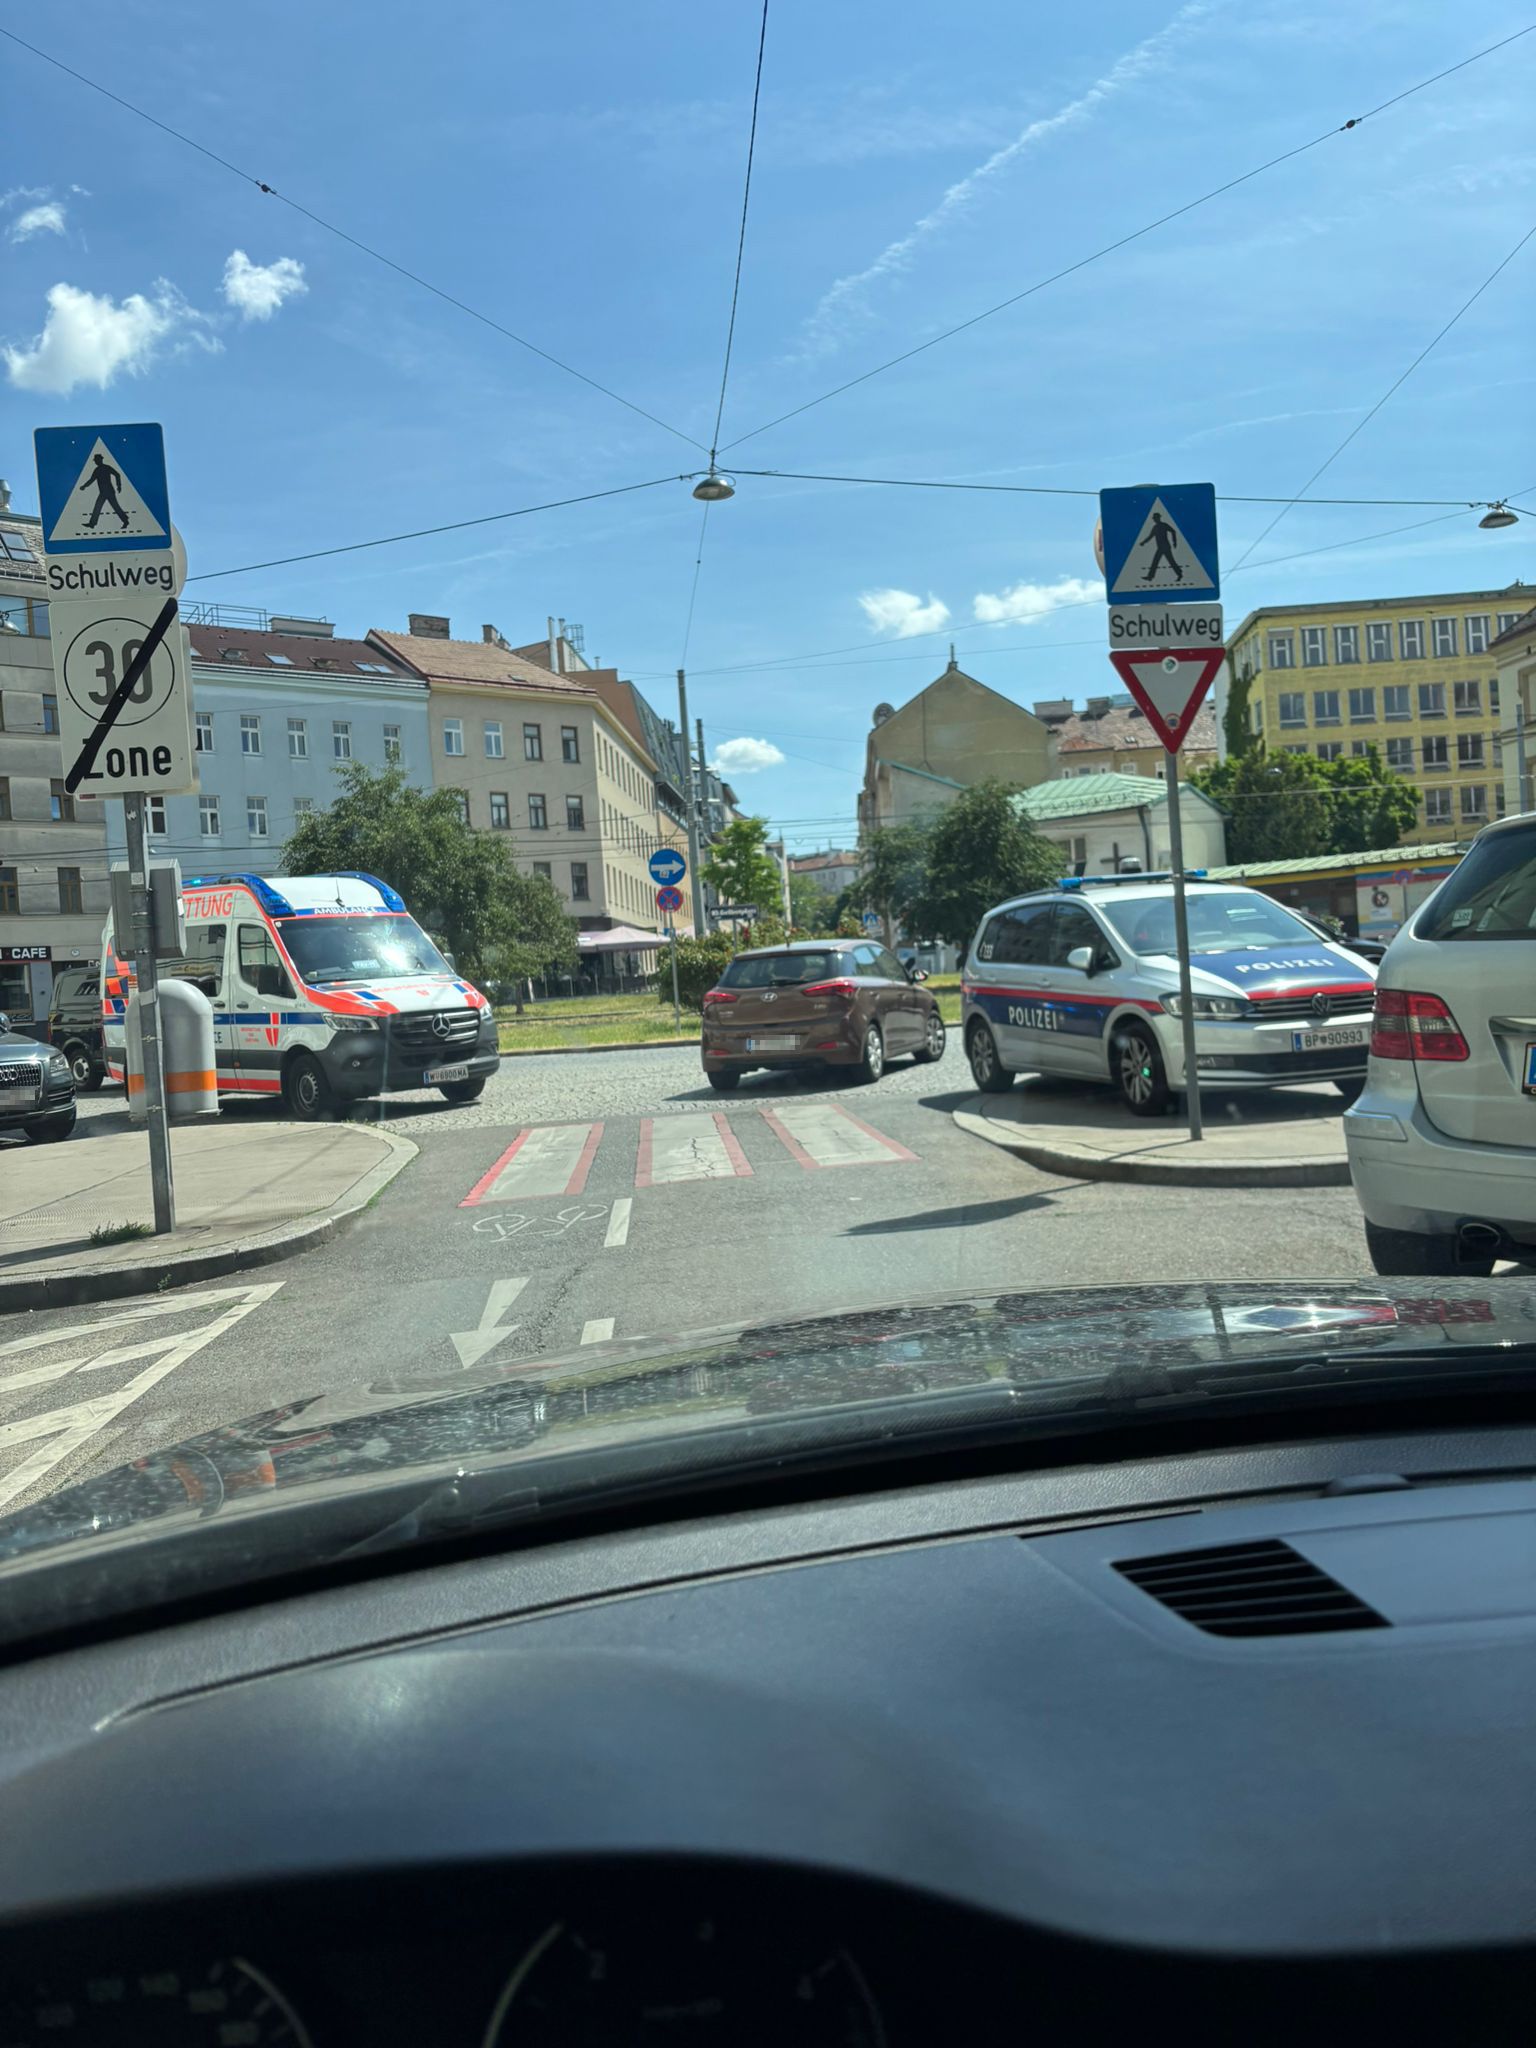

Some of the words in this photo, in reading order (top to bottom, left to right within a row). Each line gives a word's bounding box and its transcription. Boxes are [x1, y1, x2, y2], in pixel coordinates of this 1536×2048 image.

[49, 561, 174, 591] Schulweg
[1111, 613, 1220, 641] Schulweg
[85, 639, 153, 706] 30
[82, 738, 172, 780] Zone
[12, 948, 47, 959] CAFE
[1235, 959, 1335, 973] POLIZEI
[1008, 1006, 1057, 1030] POLIZEI
[1305, 1032, 1320, 1048] BP
[1328, 1030, 1363, 1045] 90993
